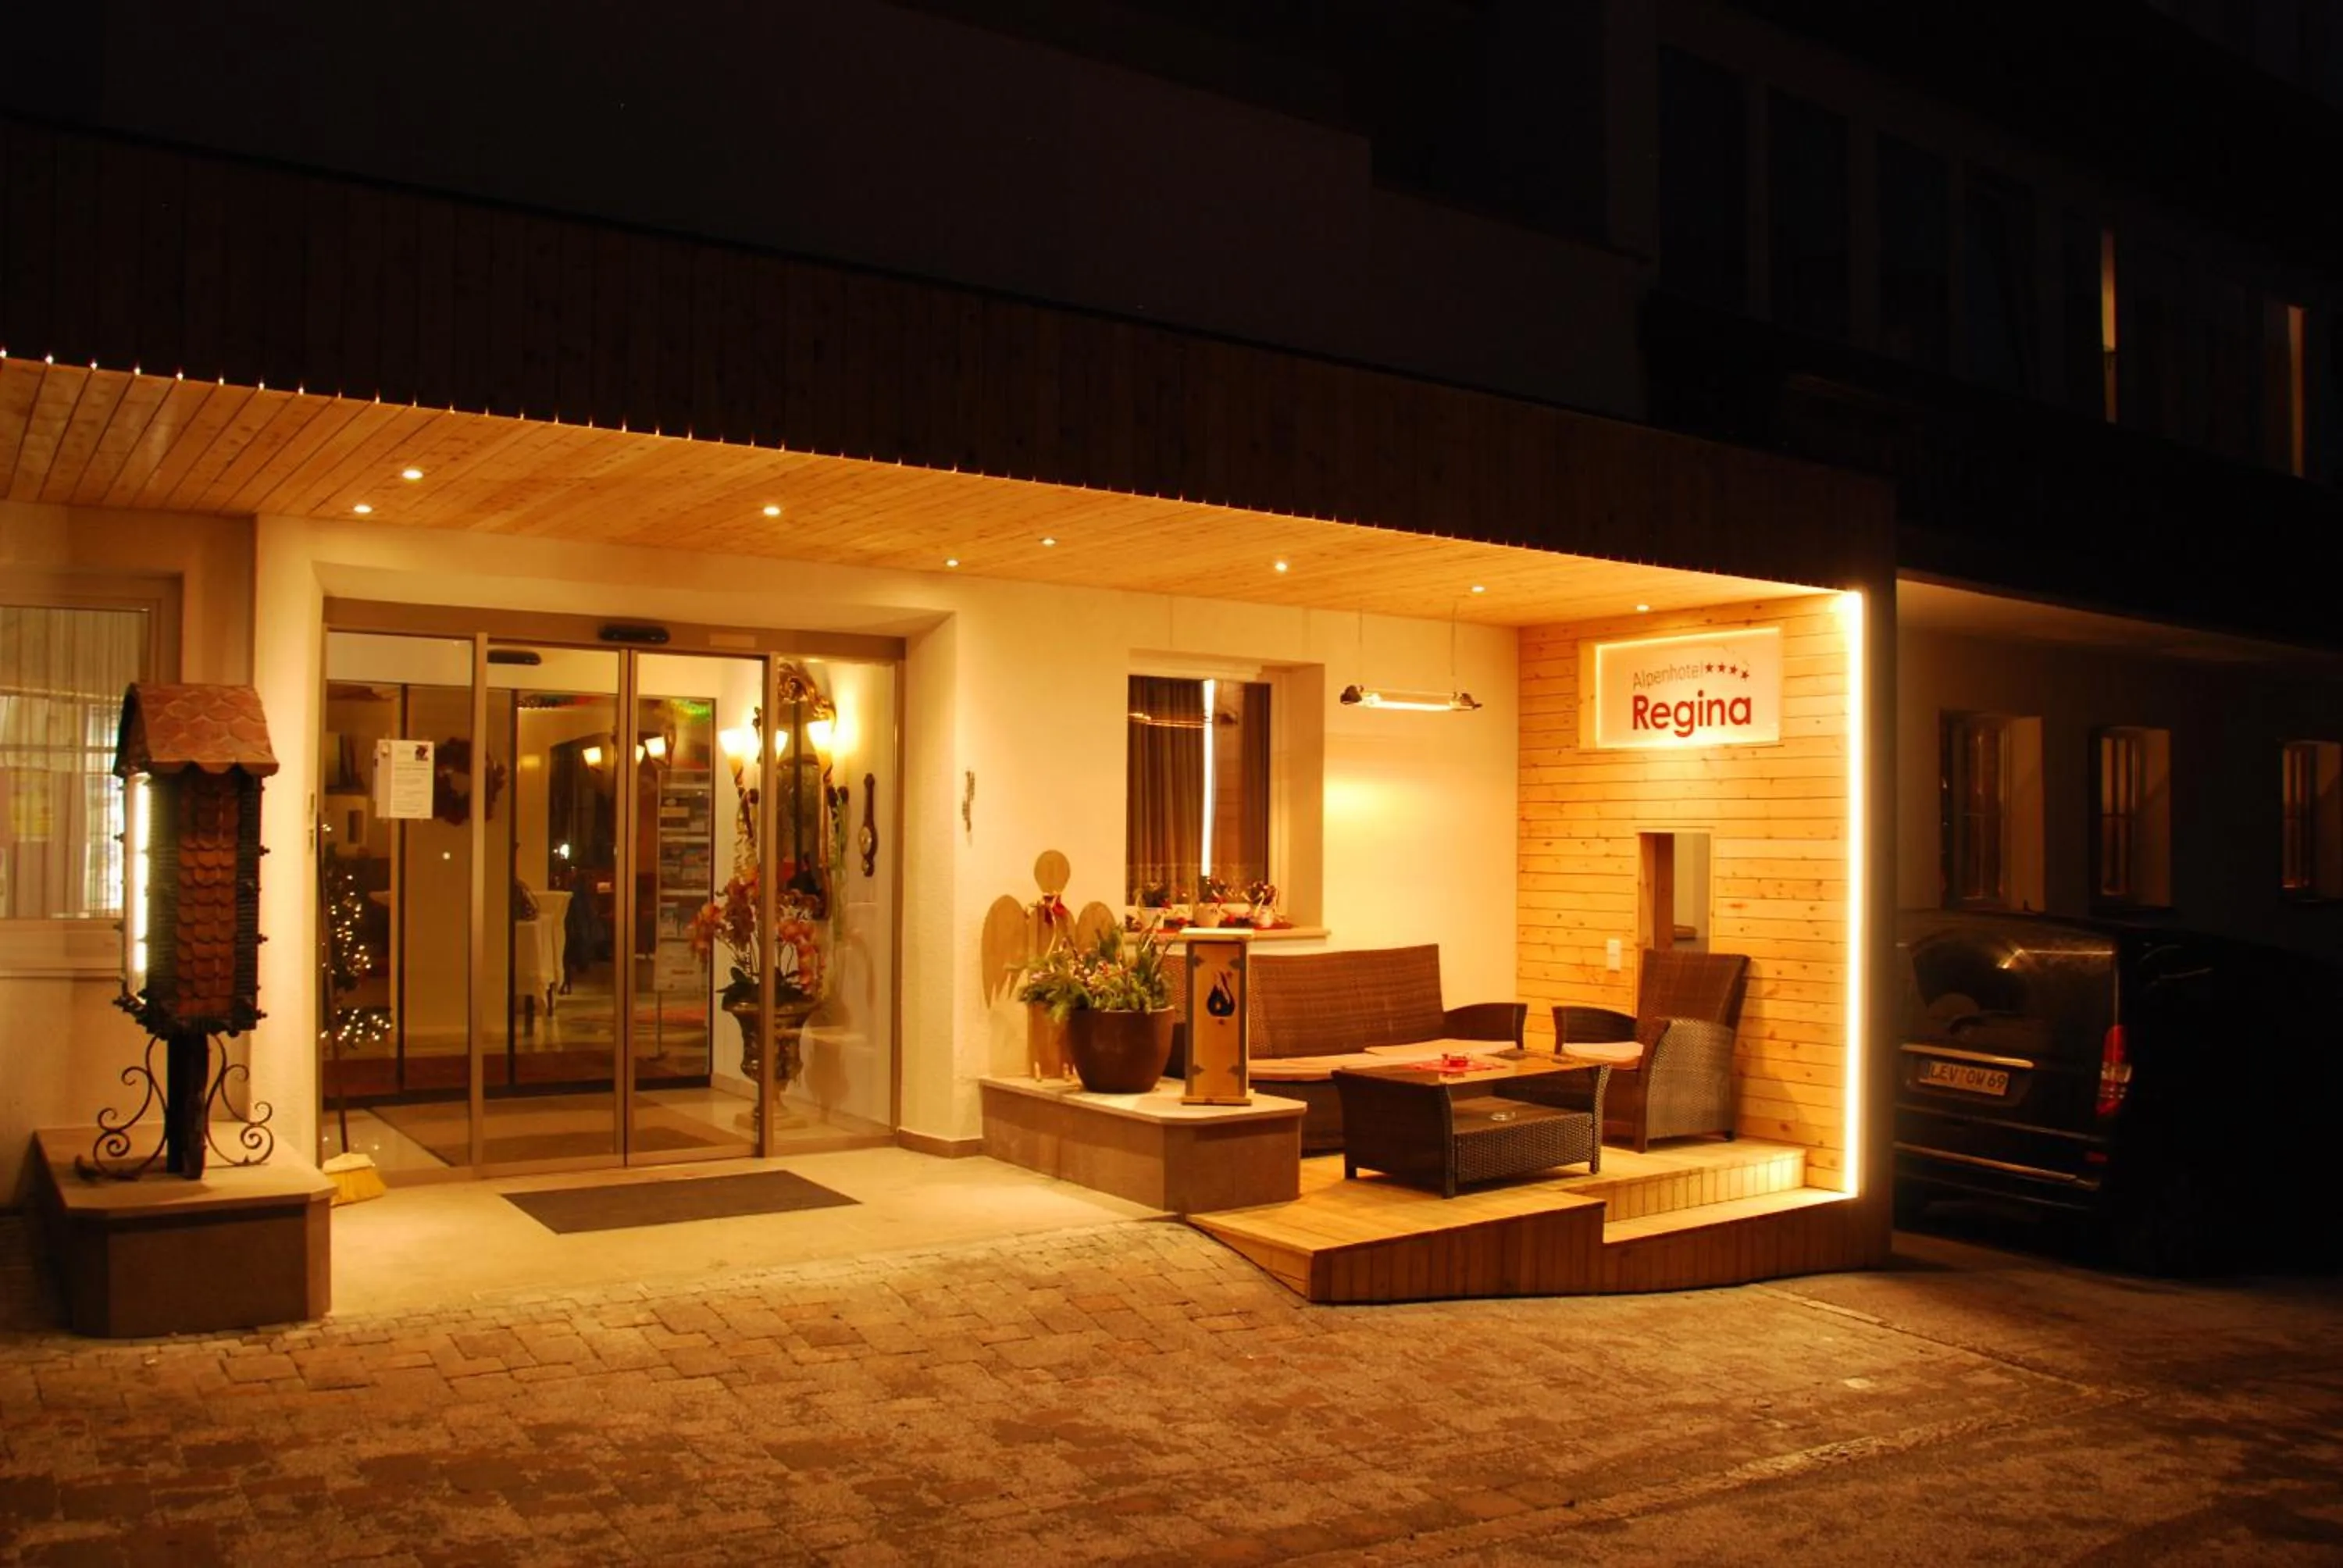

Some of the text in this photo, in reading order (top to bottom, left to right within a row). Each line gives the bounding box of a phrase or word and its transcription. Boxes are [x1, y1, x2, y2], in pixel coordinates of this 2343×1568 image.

[1632, 661, 1704, 690] Alpenhotel
[1632, 690, 1752, 738] Regina
[1931, 1064, 1959, 1082] LEV
